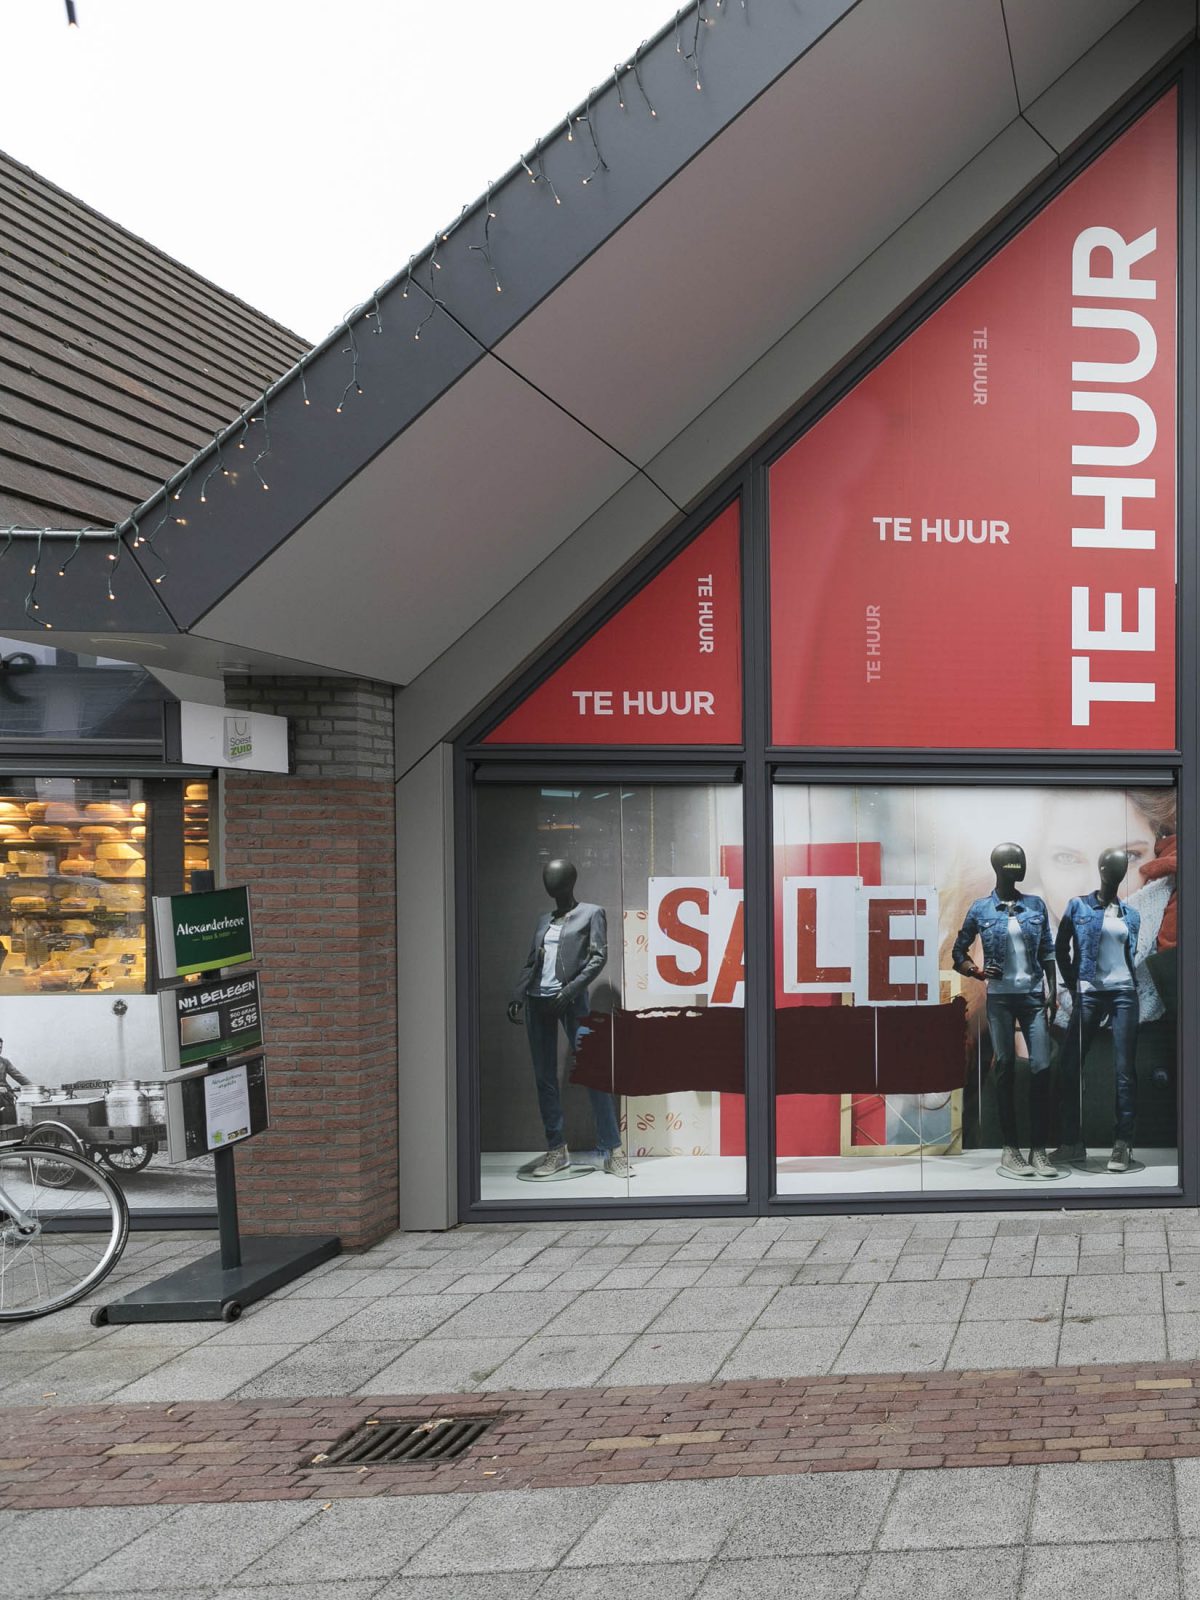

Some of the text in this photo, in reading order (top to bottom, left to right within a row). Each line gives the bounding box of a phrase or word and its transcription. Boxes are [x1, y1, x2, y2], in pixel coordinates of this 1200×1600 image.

[972, 326, 988, 406] TE HUUR
[1071, 226, 1158, 727] TE HUUR
[872, 516, 1010, 545] TE HUUR
[697, 574, 714, 654] TE HUUR
[866, 604, 881, 683] TE HUUR
[572, 690, 716, 716] TE HUUR
[229, 735, 252, 746] Soest
[229, 744, 253, 756] ZUID
[176, 916, 245, 936] Alexanderhoeve
[178, 995, 198, 1010] NH
[200, 980, 256, 1005] BELEGEN
